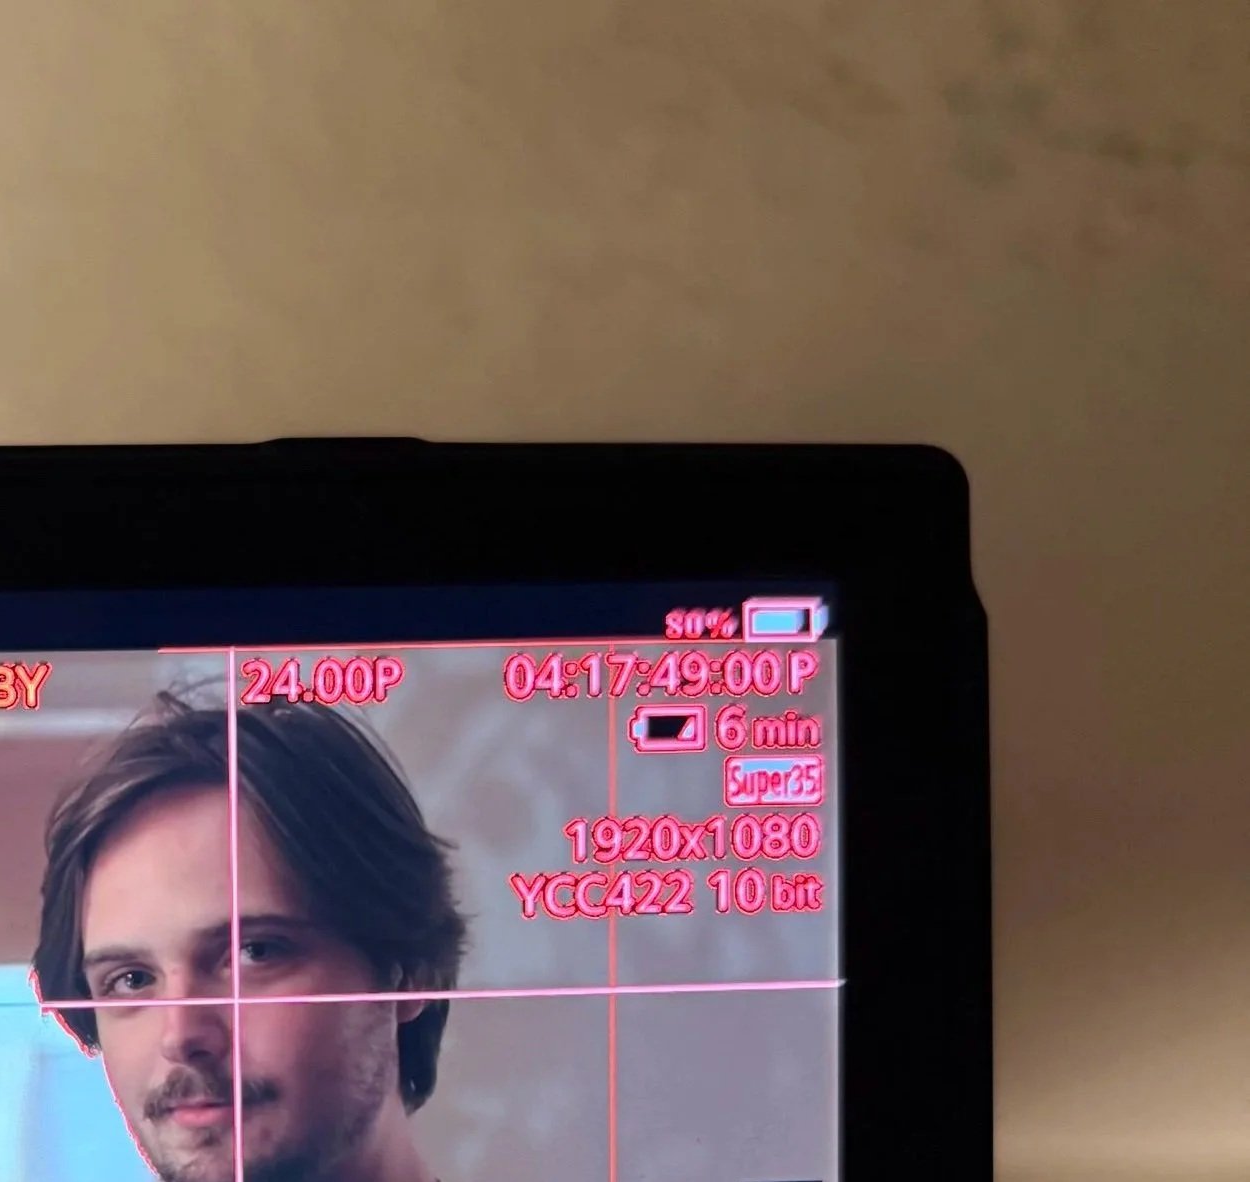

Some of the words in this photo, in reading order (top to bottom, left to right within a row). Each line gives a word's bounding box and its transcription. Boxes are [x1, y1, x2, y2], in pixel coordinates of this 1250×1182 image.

[664, 609, 738, 640] 80%
[241, 656, 405, 704] 24.00P
[715, 703, 747, 751] 6
[752, 711, 821, 749] min
[730, 763, 819, 803] Super35
[563, 814, 820, 863] 1920x1080
[511, 868, 694, 919] YCC422
[707, 867, 766, 914] 10
[771, 874, 824, 913] bit
